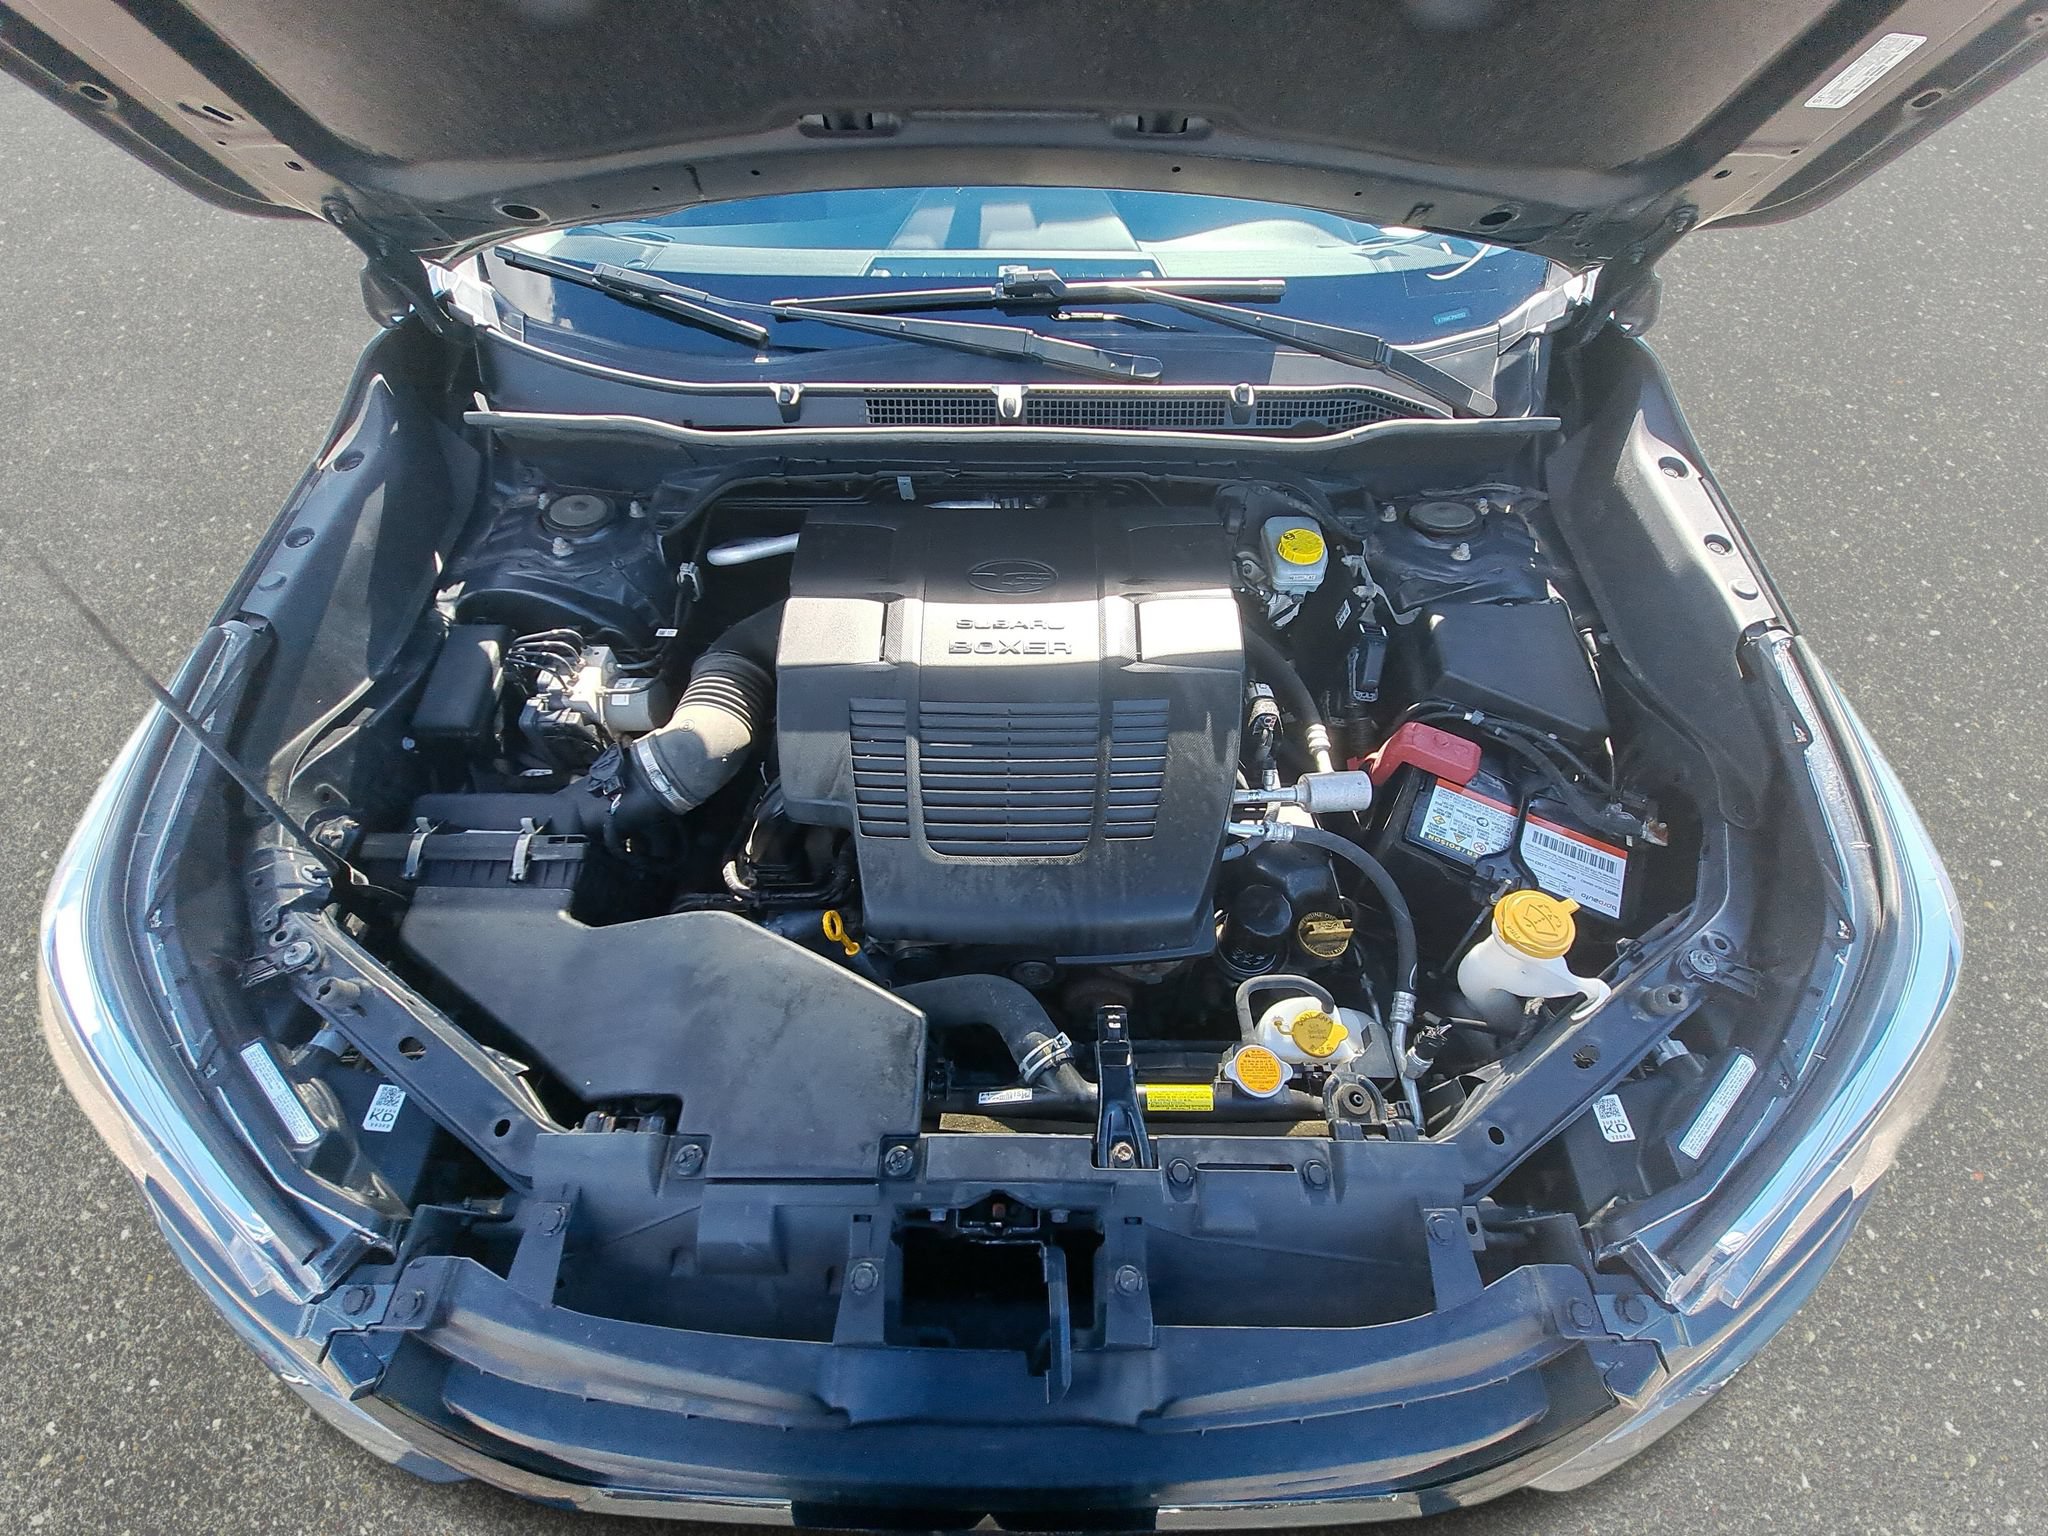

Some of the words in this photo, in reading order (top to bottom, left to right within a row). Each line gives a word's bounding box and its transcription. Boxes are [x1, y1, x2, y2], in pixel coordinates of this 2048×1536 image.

[956, 619, 1065, 630] SUBARU
[948, 640, 1072, 655] BOXER
[1427, 834, 1461, 851] POISON
[1580, 892, 1618, 912] bproauto
[369, 1111, 394, 1122] KD
[1604, 1123, 1628, 1134] KD
